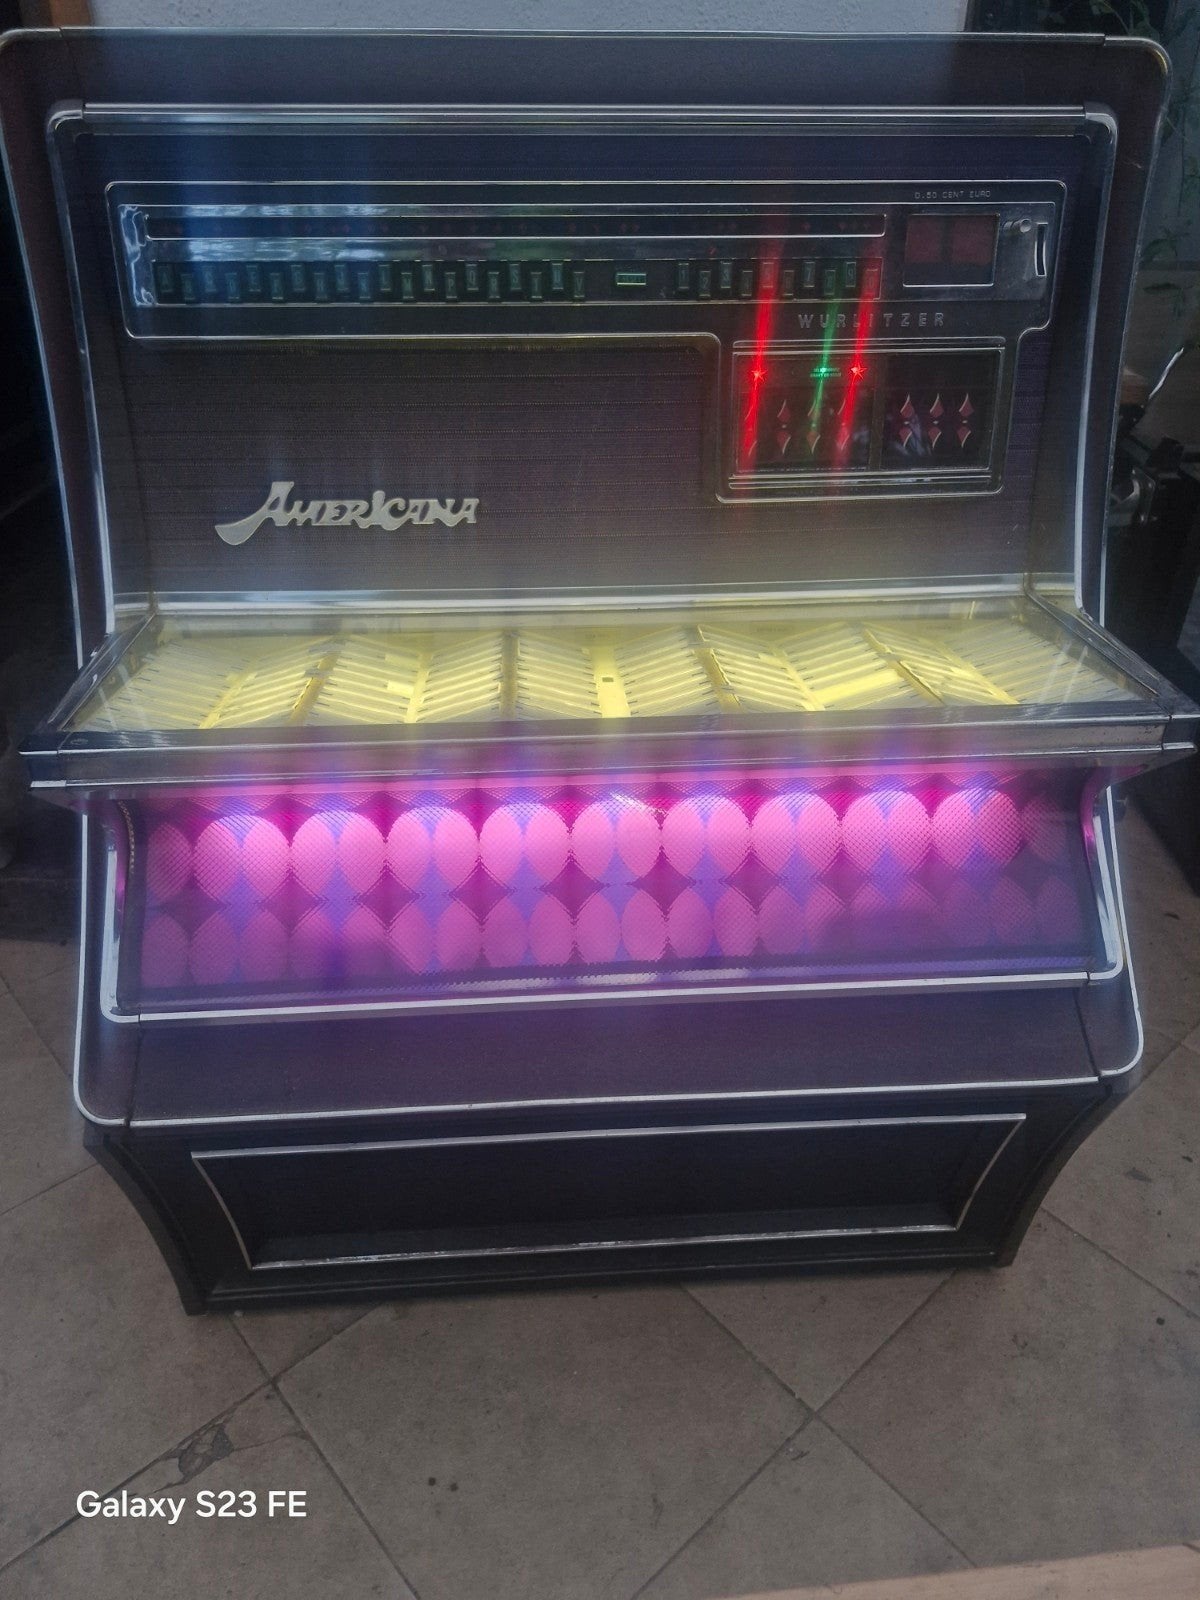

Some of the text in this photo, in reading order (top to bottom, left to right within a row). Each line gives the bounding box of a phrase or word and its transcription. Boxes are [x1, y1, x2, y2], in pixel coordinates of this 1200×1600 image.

[942, 190, 965, 198] CENT
[969, 190, 991, 198] EURO
[798, 312, 945, 329] WURLITZER
